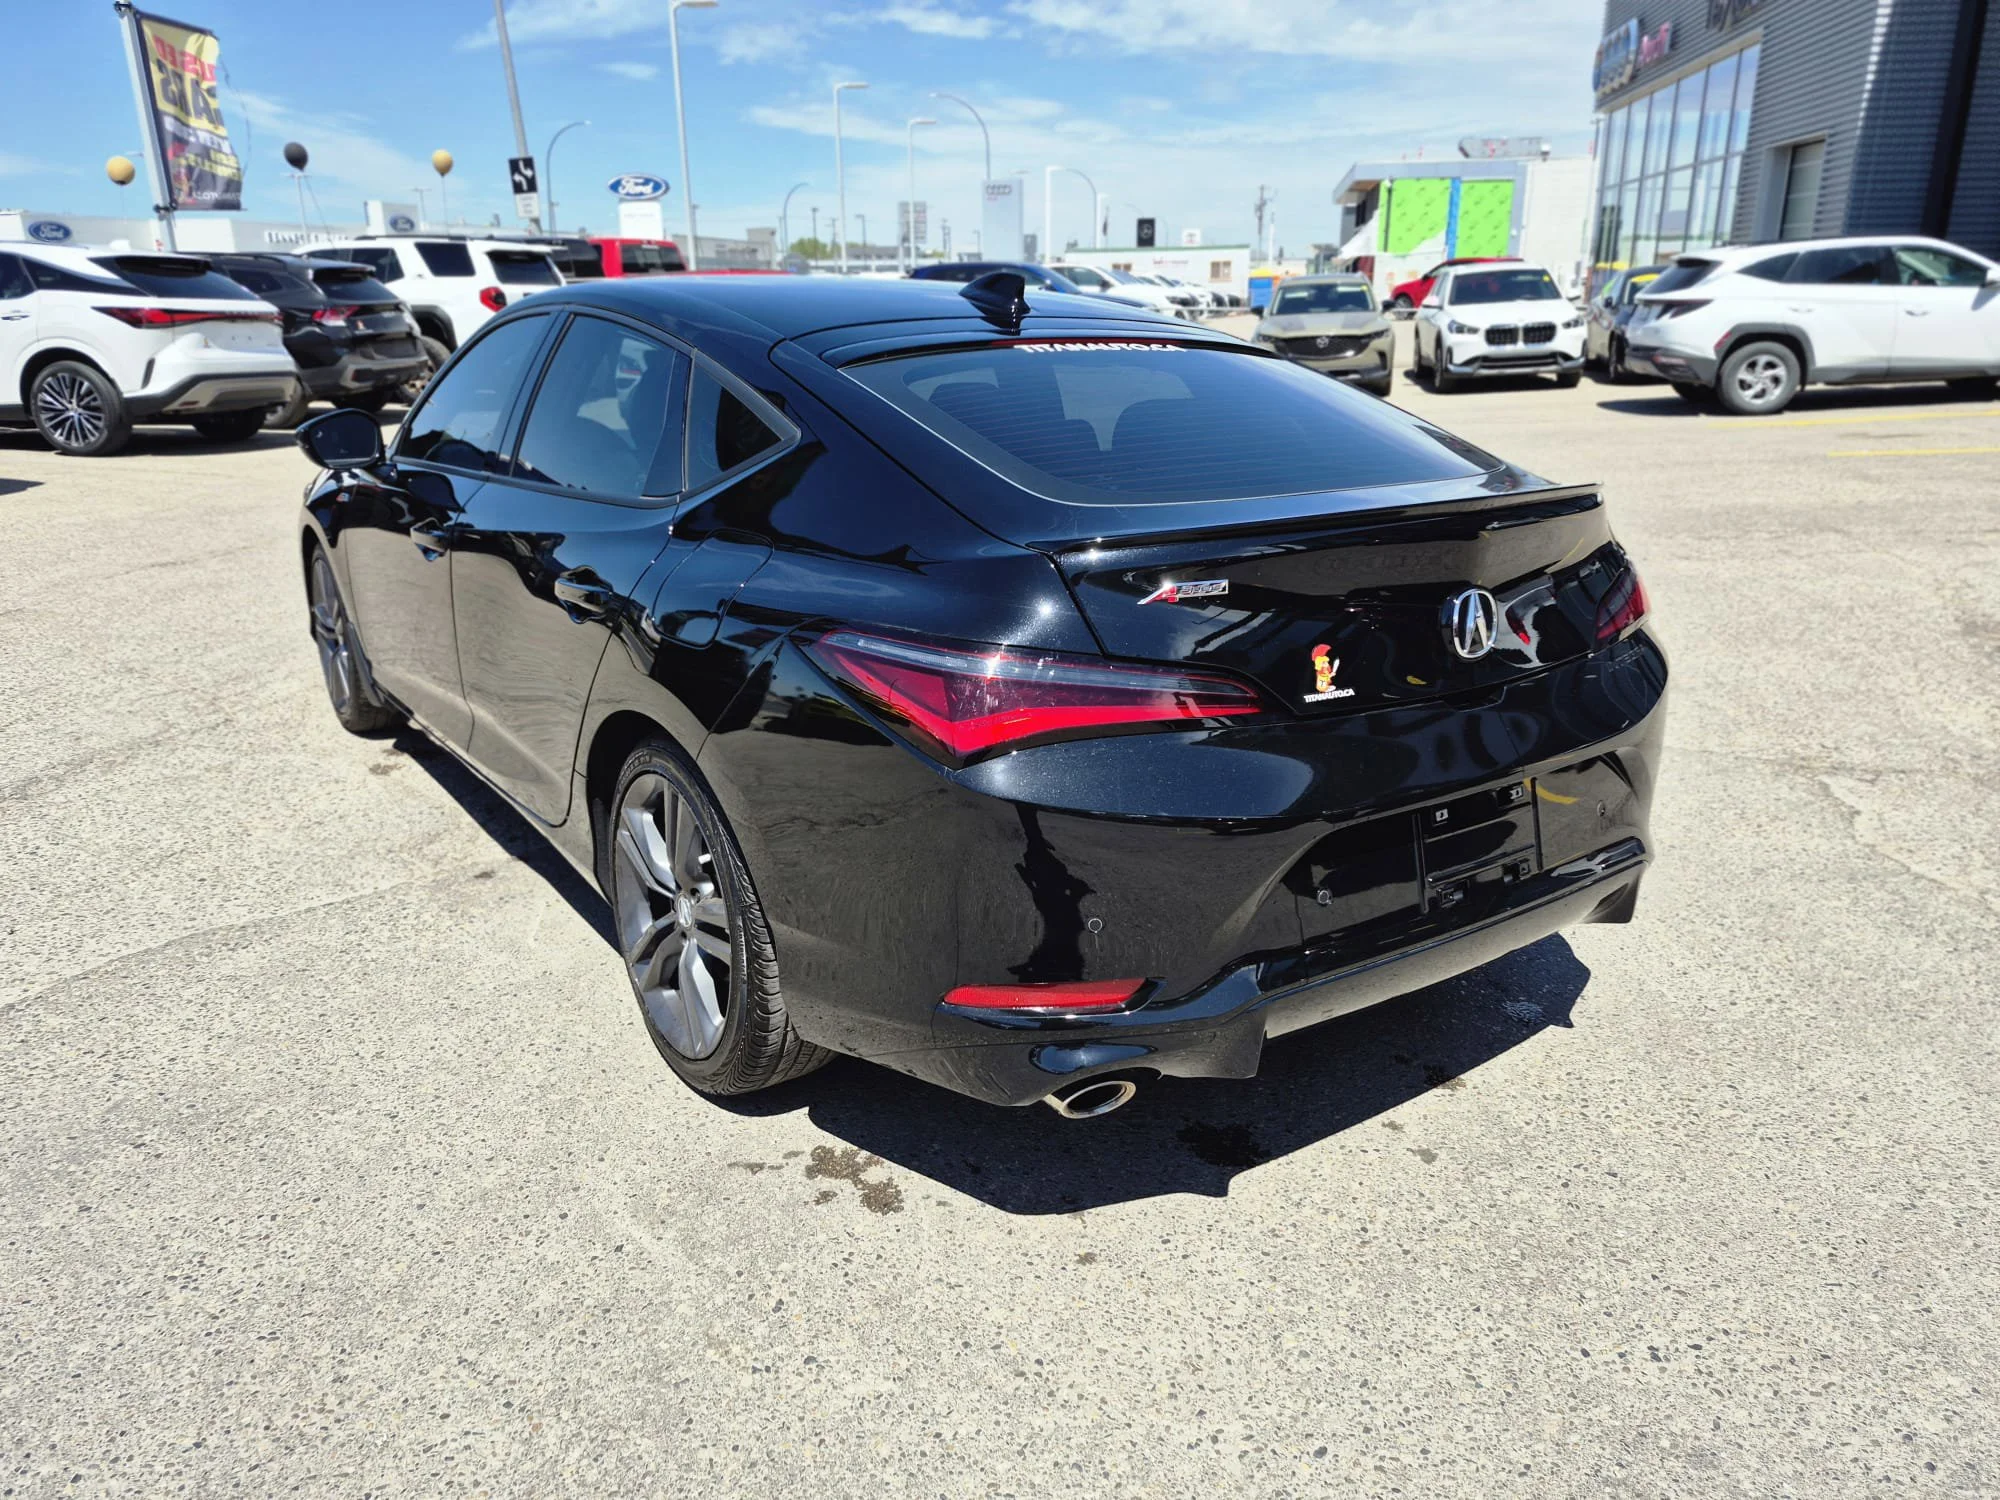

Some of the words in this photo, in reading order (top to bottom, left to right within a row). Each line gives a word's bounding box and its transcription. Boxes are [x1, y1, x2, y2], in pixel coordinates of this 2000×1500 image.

[618, 174, 654, 195] Ford
[1013, 342, 1188, 353] TITANAUTO.CA
[1303, 688, 1356, 703] TITANAUTO.CA
